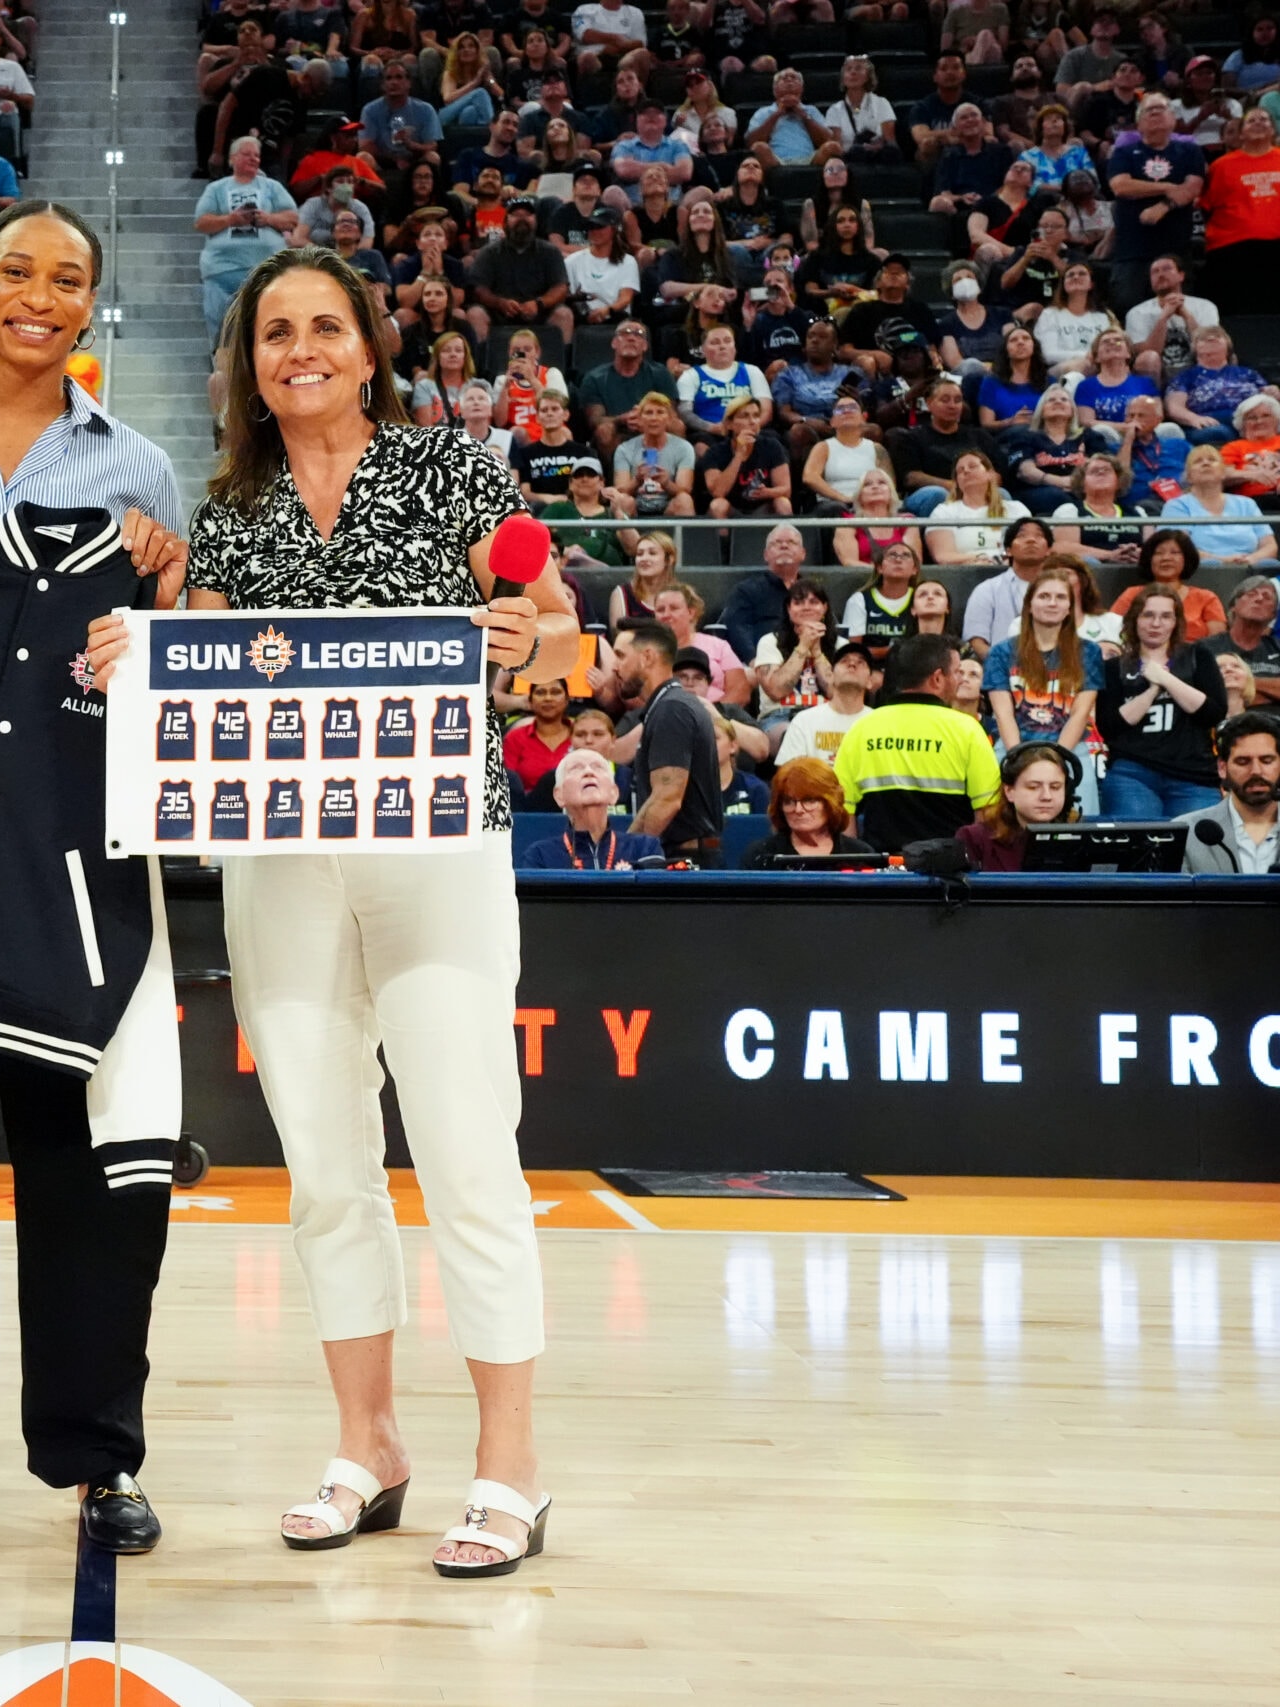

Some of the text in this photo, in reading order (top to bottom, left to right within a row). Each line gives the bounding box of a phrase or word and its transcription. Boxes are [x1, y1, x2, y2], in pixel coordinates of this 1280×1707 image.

[530, 456, 578, 468] WNBA
[977, 532, 985, 547] 5
[867, 624, 907, 636] DALL
[166, 643, 241, 671] SUN
[301, 640, 465, 669] LEGENDS
[165, 711, 188, 732] 12
[217, 711, 245, 732] 42
[272, 711, 299, 731] 23
[330, 709, 353, 730] 13
[385, 708, 408, 729] 15
[444, 707, 460, 728] 11
[1142, 704, 1174, 733] 31
[388, 729, 413, 737] JONES
[867, 737, 943, 753] SECURITY
[161, 791, 189, 812] 35
[216, 801, 244, 809] MILLER
[220, 794, 241, 802] CURT
[276, 790, 292, 810] 5
[324, 789, 353, 810] 25
[382, 788, 405, 809] 31
[724, 1007, 1022, 1082] CAME
